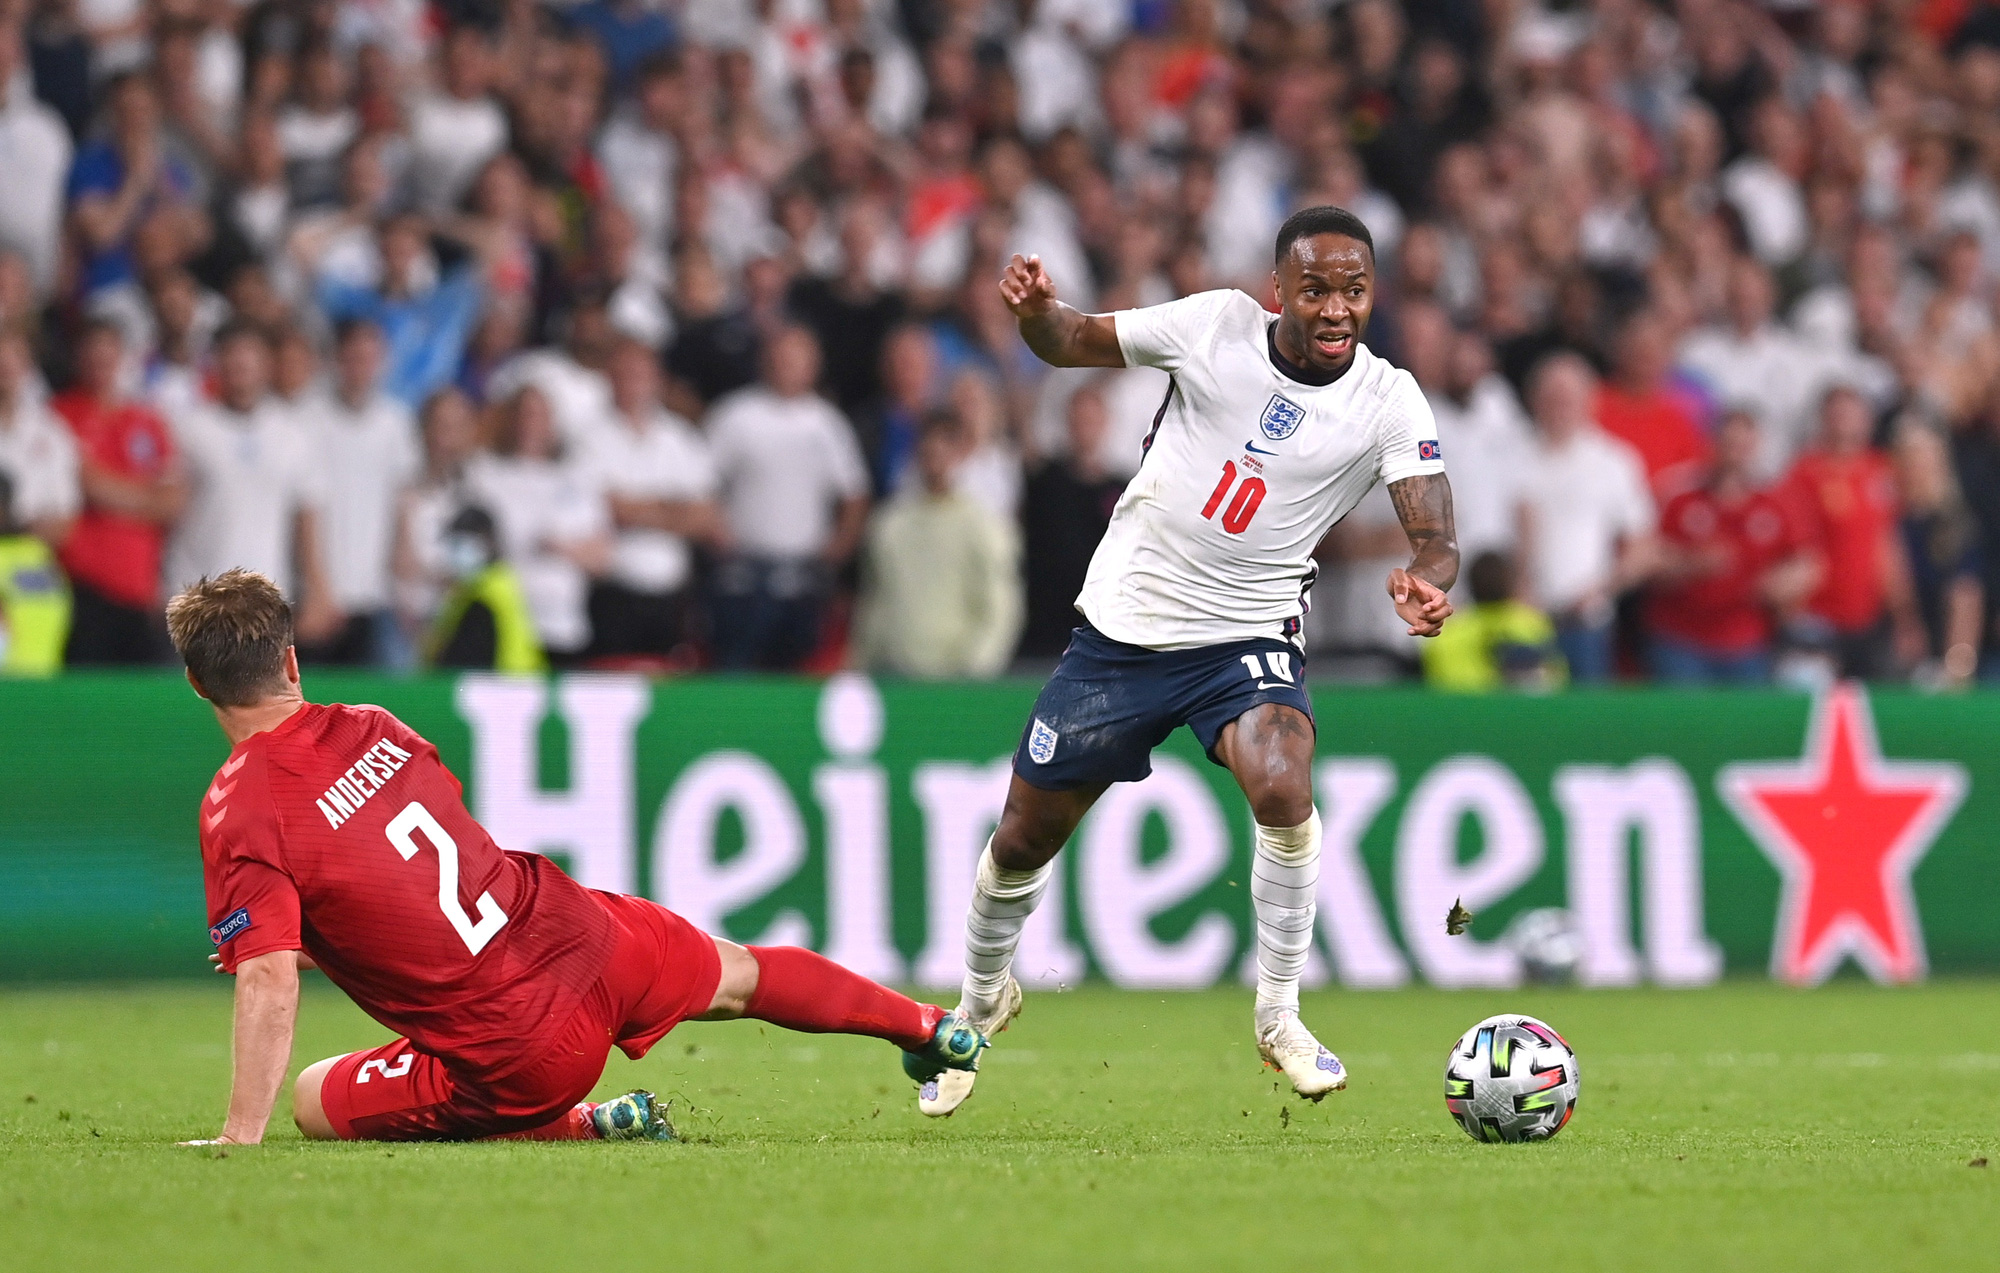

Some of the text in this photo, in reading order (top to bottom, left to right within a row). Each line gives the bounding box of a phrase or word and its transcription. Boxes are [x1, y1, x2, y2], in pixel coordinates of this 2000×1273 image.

[1243, 454, 1264, 469] DENMARK
[1200, 459, 1267, 535] 10
[1240, 651, 1295, 683] 10
[315, 737, 413, 831] ANDERSEN
[455, 672, 1723, 988] Heineken
[385, 801, 509, 957] 2
[220, 912, 248, 936] RESPECT
[356, 1053, 414, 1084] 2
